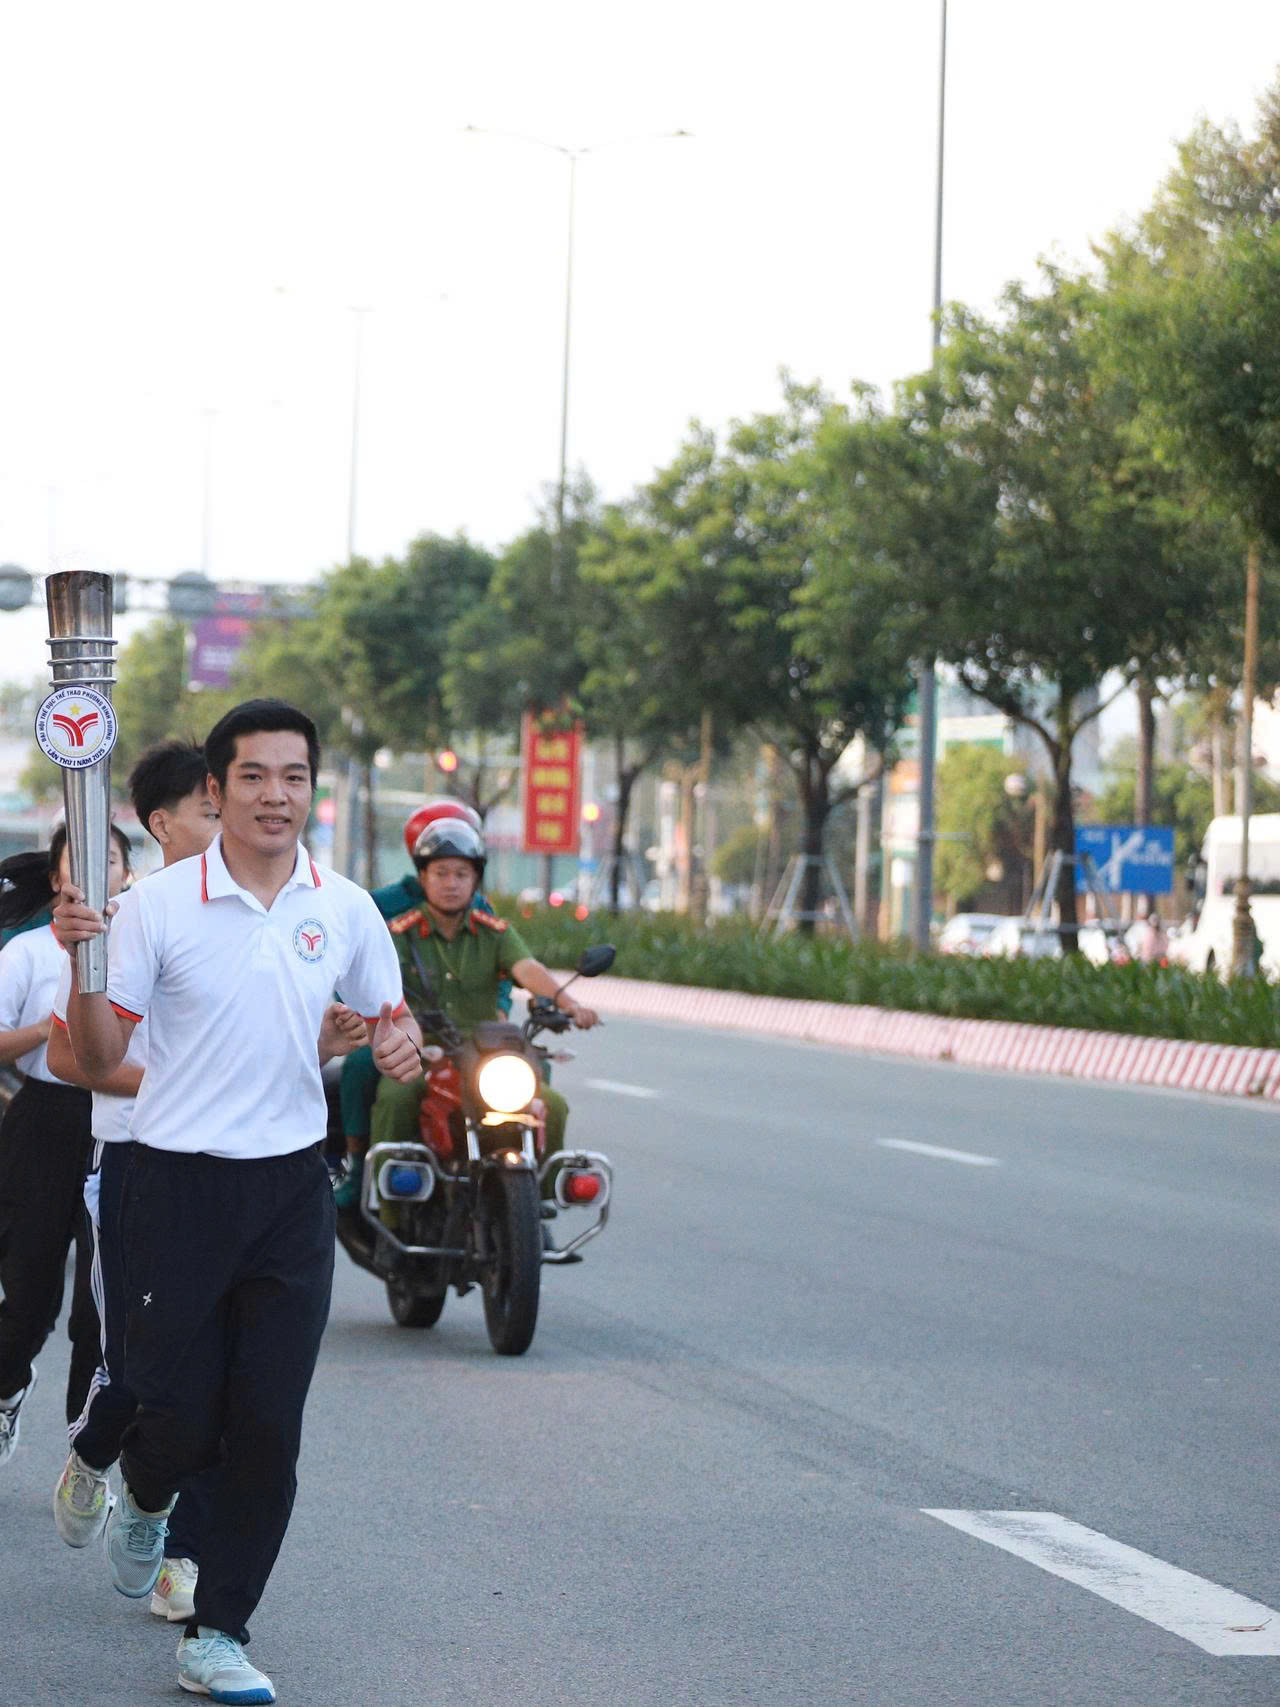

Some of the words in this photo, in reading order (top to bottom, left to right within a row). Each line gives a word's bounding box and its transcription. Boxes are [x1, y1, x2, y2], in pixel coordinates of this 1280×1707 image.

[46, 699, 56, 709] DỤC
[102, 706, 110, 719] BÌNH
[77, 757, 92, 766] NĂM
[92, 748, 105, 760] 2025
